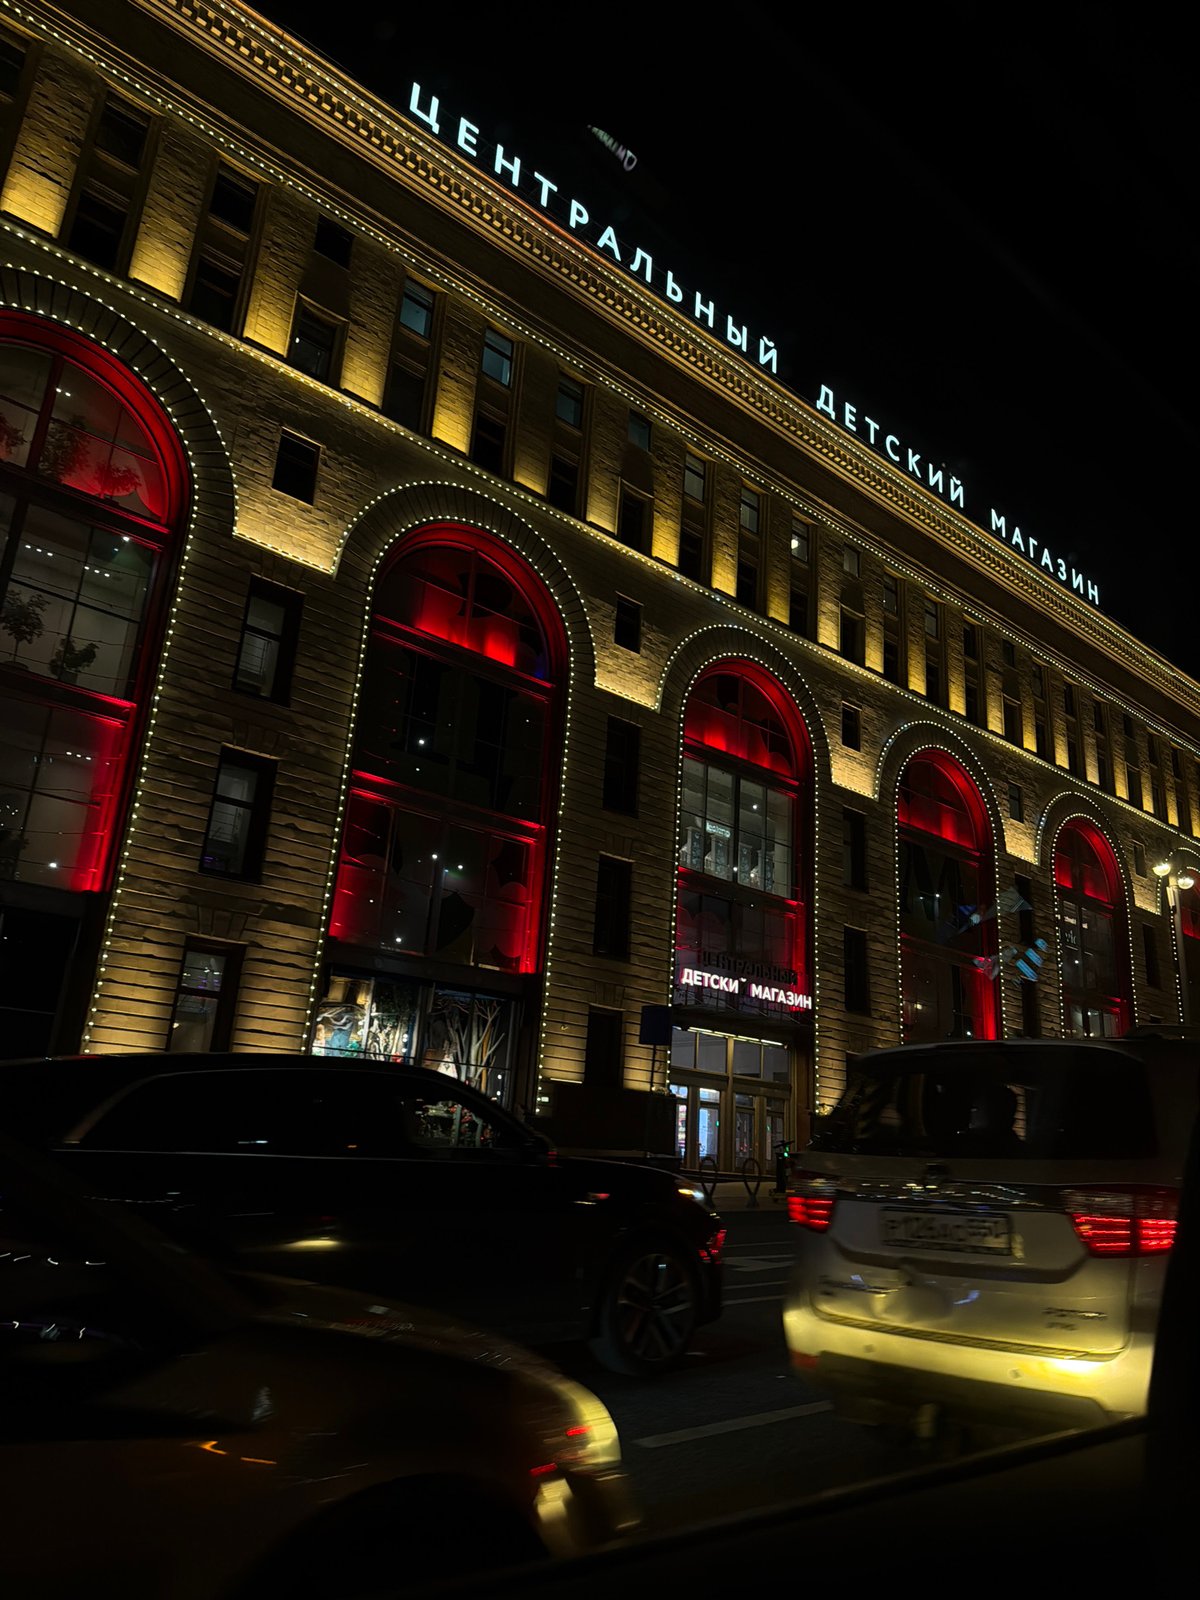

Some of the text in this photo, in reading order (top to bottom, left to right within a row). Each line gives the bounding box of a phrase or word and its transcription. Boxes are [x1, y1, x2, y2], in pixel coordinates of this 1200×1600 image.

[409, 81, 1099, 605] ЦЕНТРАЛЬНЫЙ ДЕТСКИЙ МАГАЗИН
[751, 983, 813, 1009] МАГАЗИН
